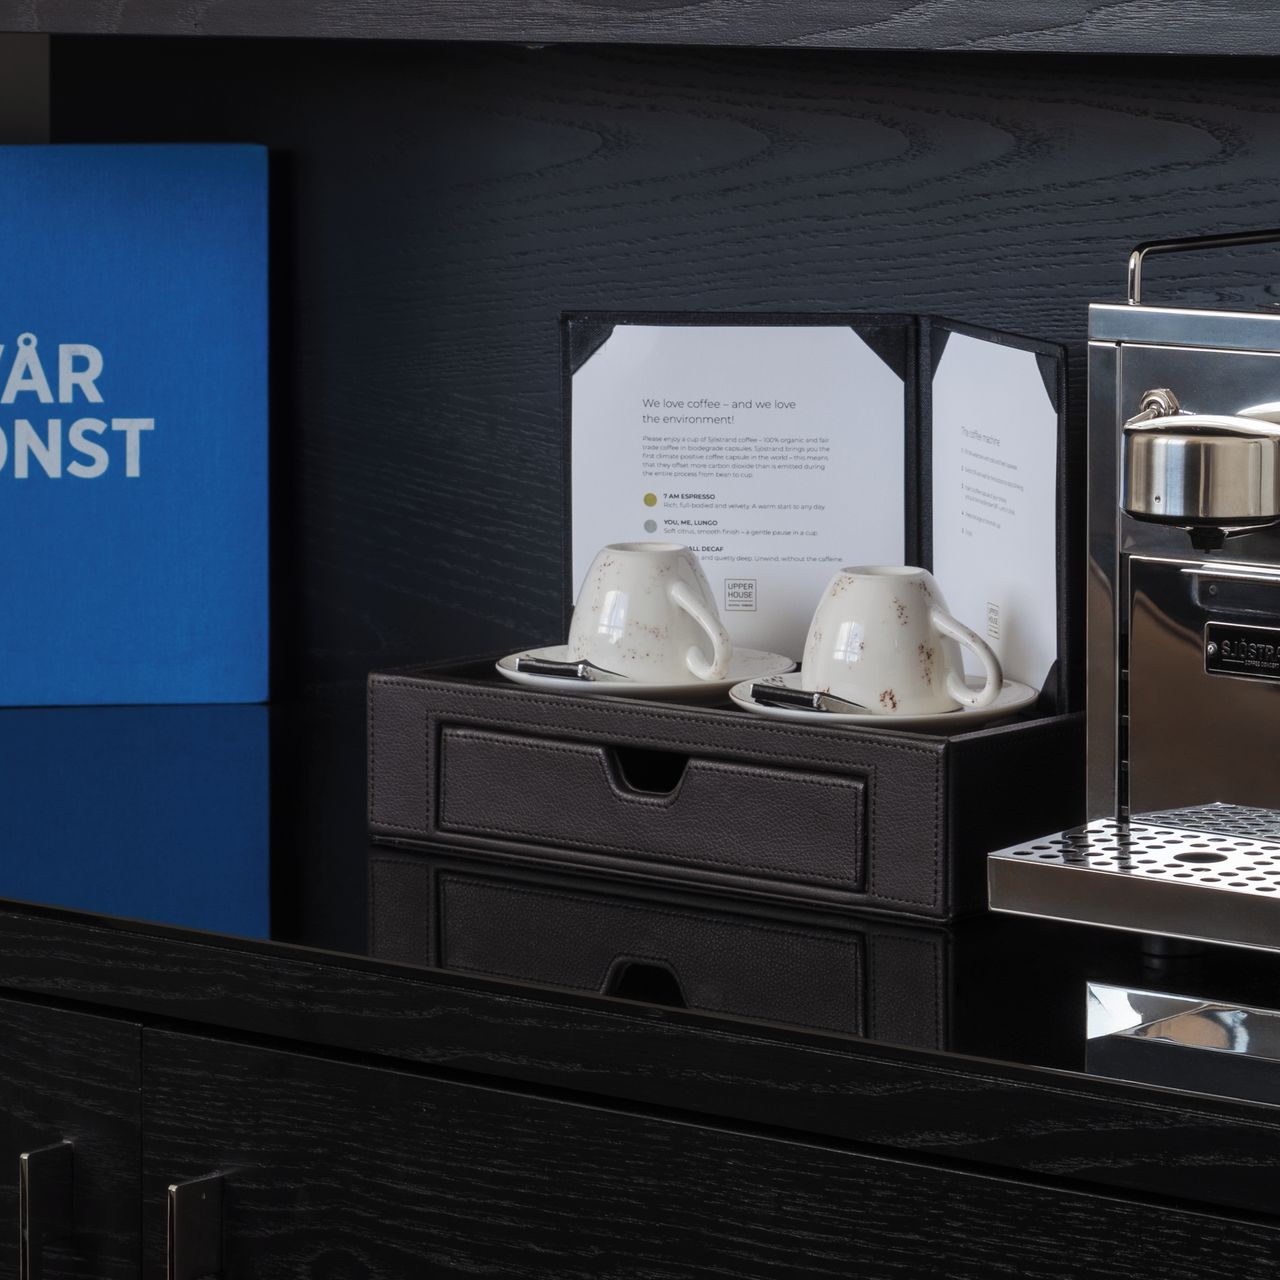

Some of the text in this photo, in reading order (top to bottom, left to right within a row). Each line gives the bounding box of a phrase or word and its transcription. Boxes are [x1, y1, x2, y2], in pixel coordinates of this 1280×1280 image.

[642, 399, 660, 408] We
[663, 399, 684, 408] love
[687, 399, 720, 409] coffee
[732, 400, 752, 409] and
[755, 401, 772, 409] we
[774, 400, 797, 409] love
[642, 414, 735, 425] the environment!
